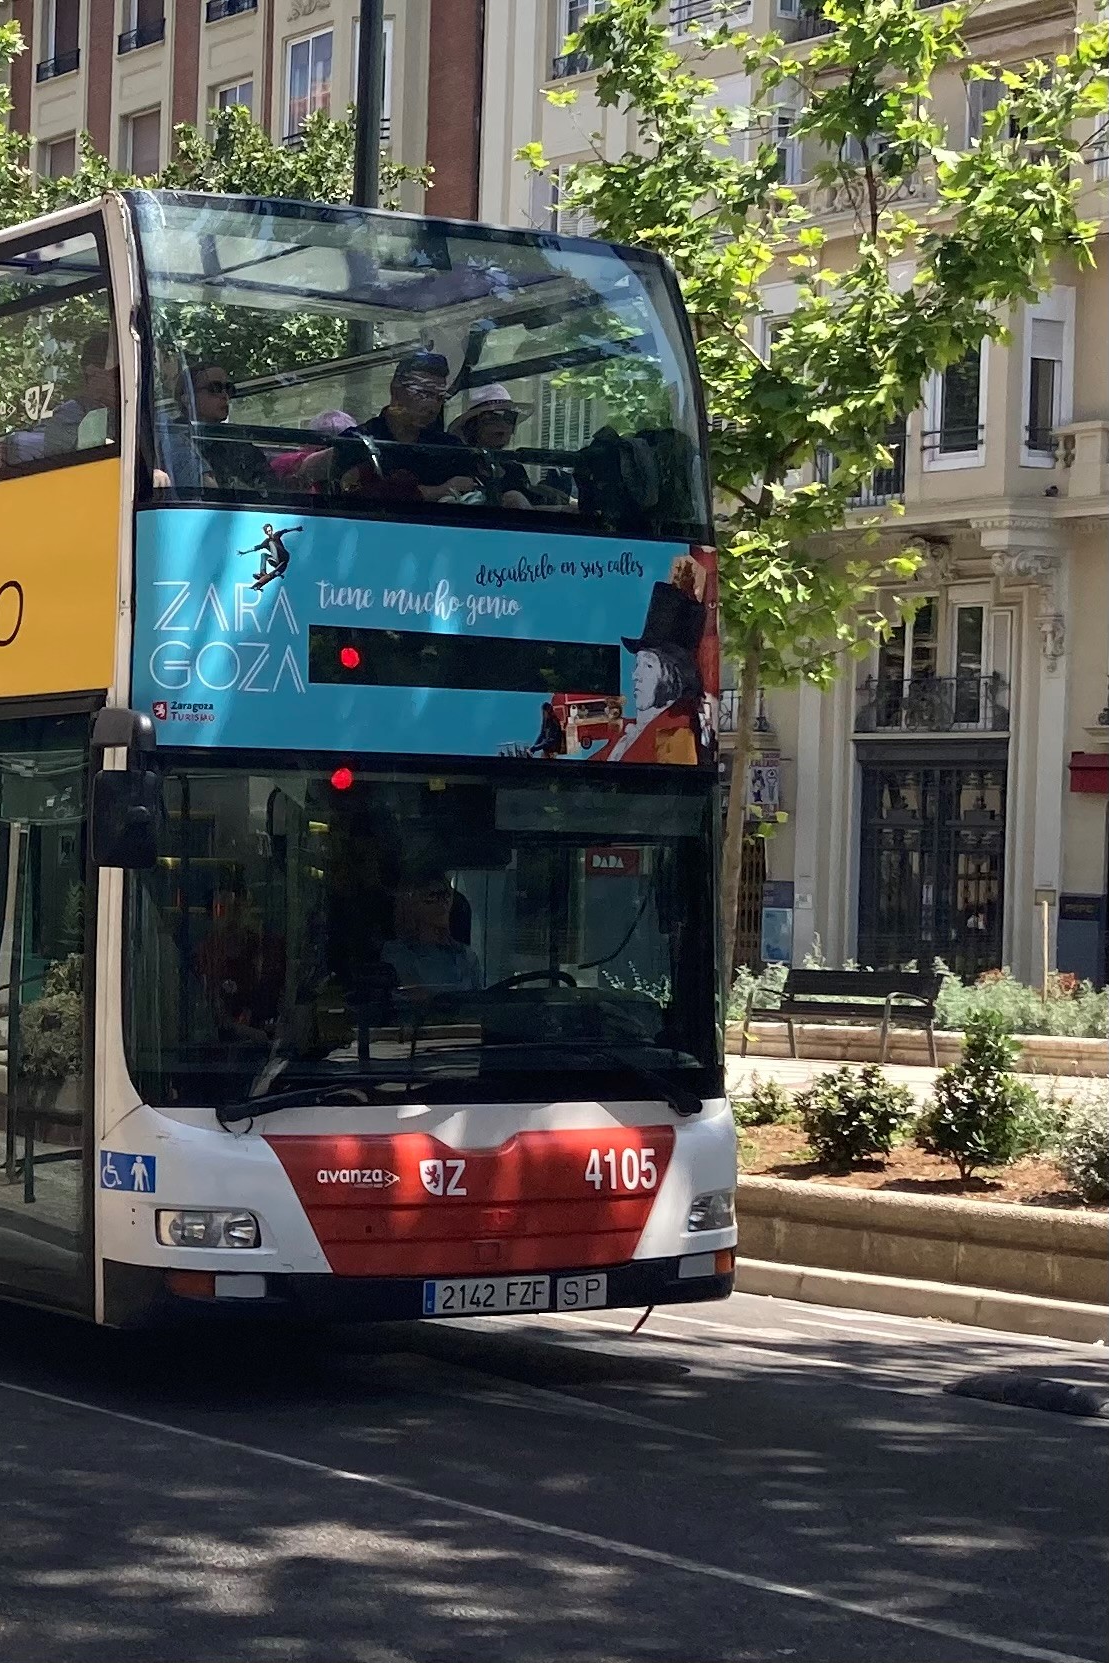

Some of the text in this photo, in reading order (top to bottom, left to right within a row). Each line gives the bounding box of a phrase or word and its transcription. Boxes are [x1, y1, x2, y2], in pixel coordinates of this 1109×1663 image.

[561, 560, 576, 575] en
[580, 560, 604, 578] sus
[607, 552, 643, 578] calles
[153, 581, 299, 634] ZARA
[315, 579, 522, 625] tiene mucho genio
[149, 640, 306, 694] GOZA
[171, 701, 213, 712] Zaragoza
[317, 1169, 383, 1183] avanza
[585, 1148, 657, 1190] 4105
[442, 1284, 494, 1309] 2142
[506, 1281, 545, 1306] FZF
